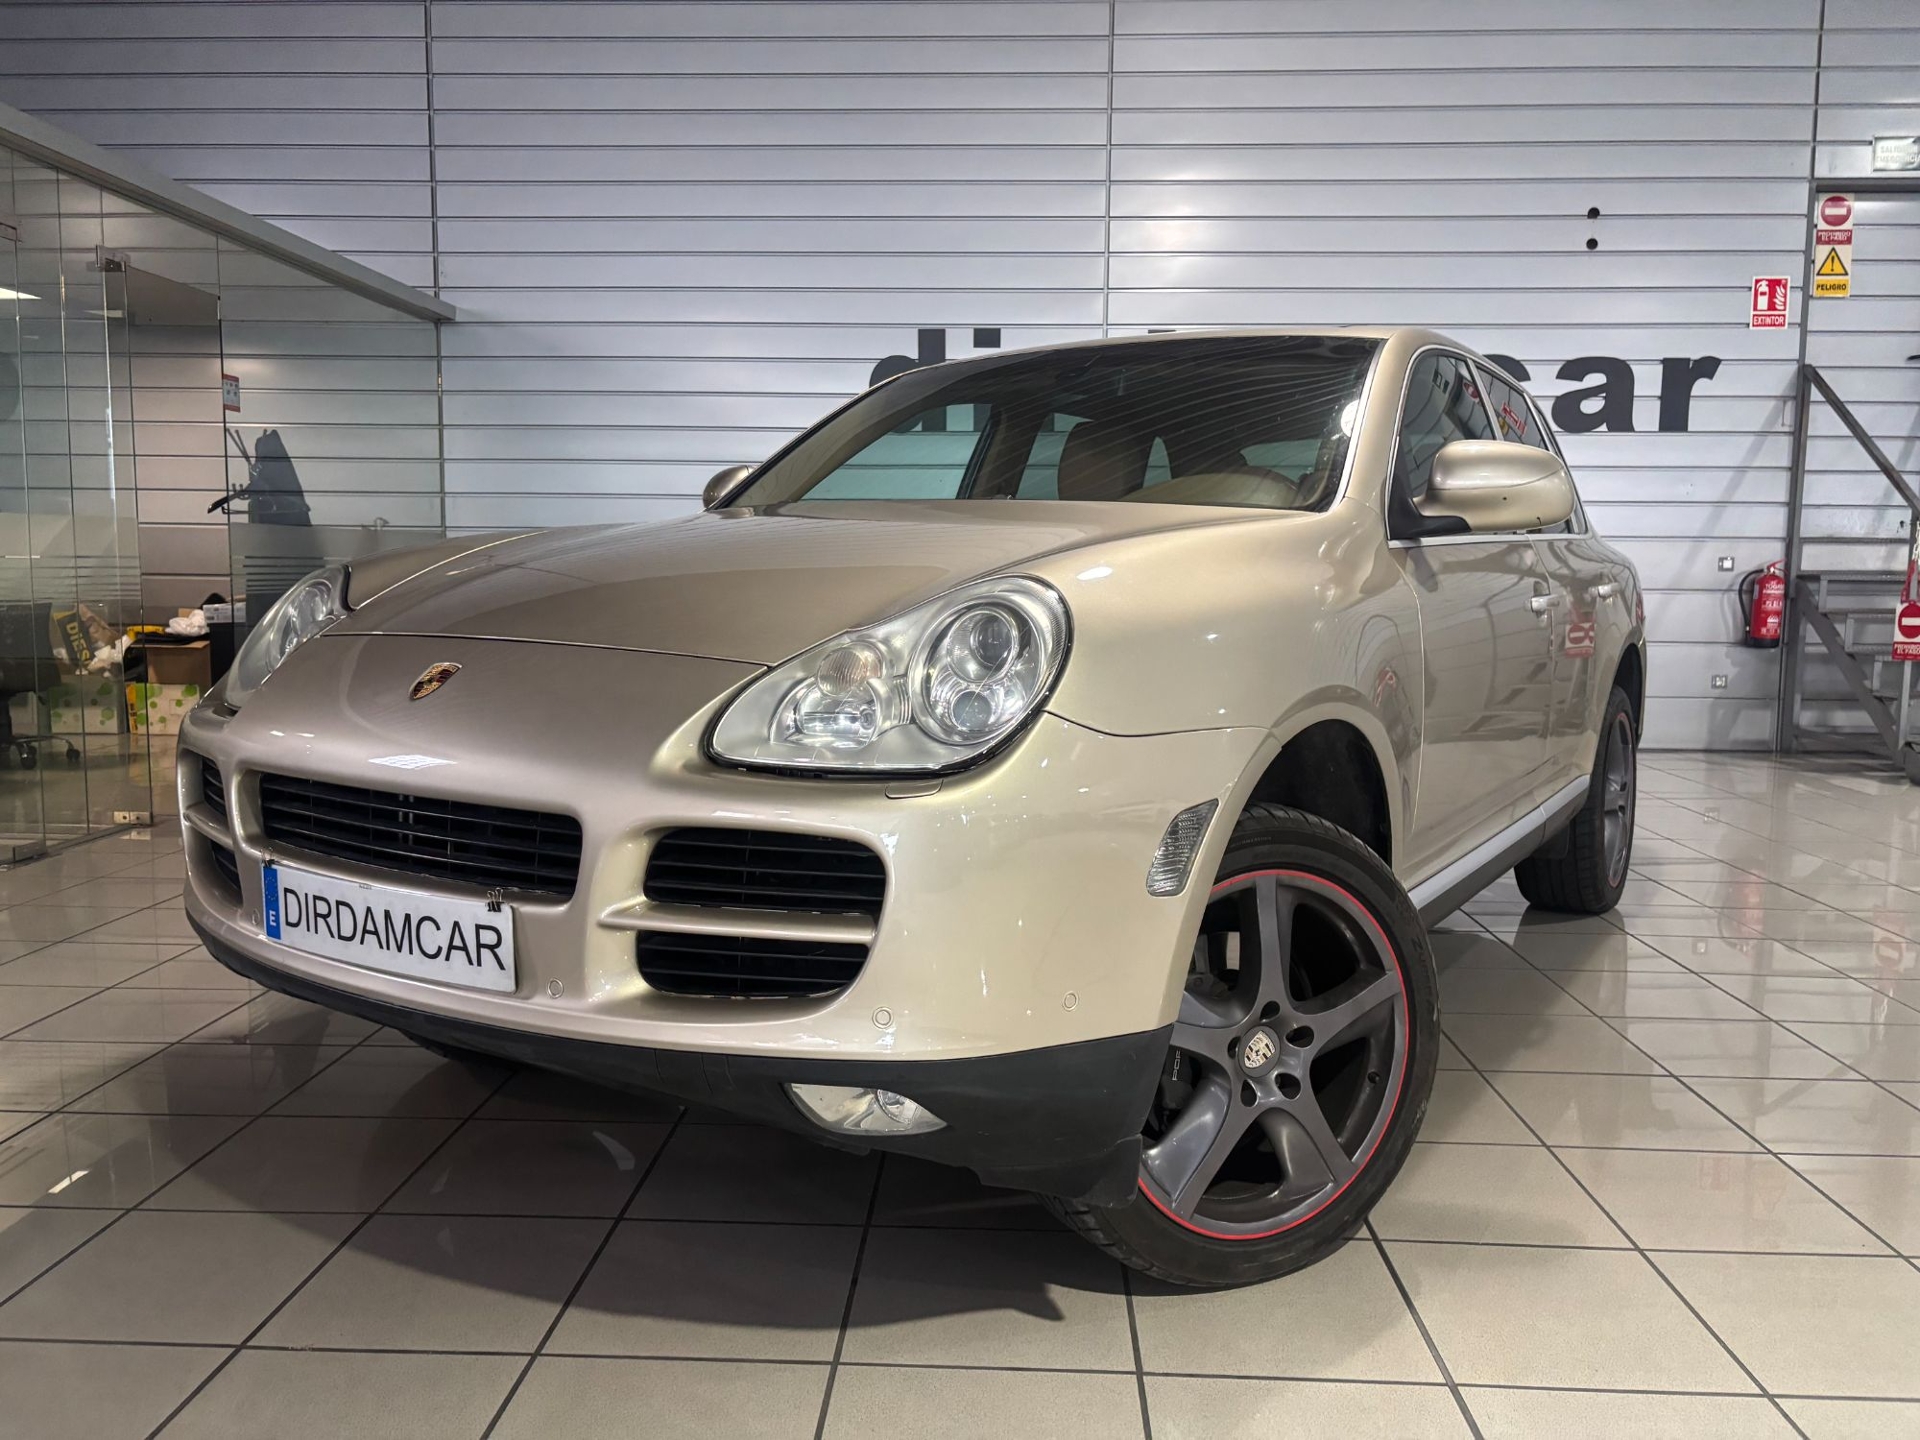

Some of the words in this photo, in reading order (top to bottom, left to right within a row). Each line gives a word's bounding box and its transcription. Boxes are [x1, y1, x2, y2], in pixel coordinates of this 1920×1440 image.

[1816, 283, 1847, 291] PELIGRO
[1753, 315, 1784, 325] EXTINTOR
[269, 909, 277, 926] E
[283, 887, 507, 971] DIRDAMCAR
